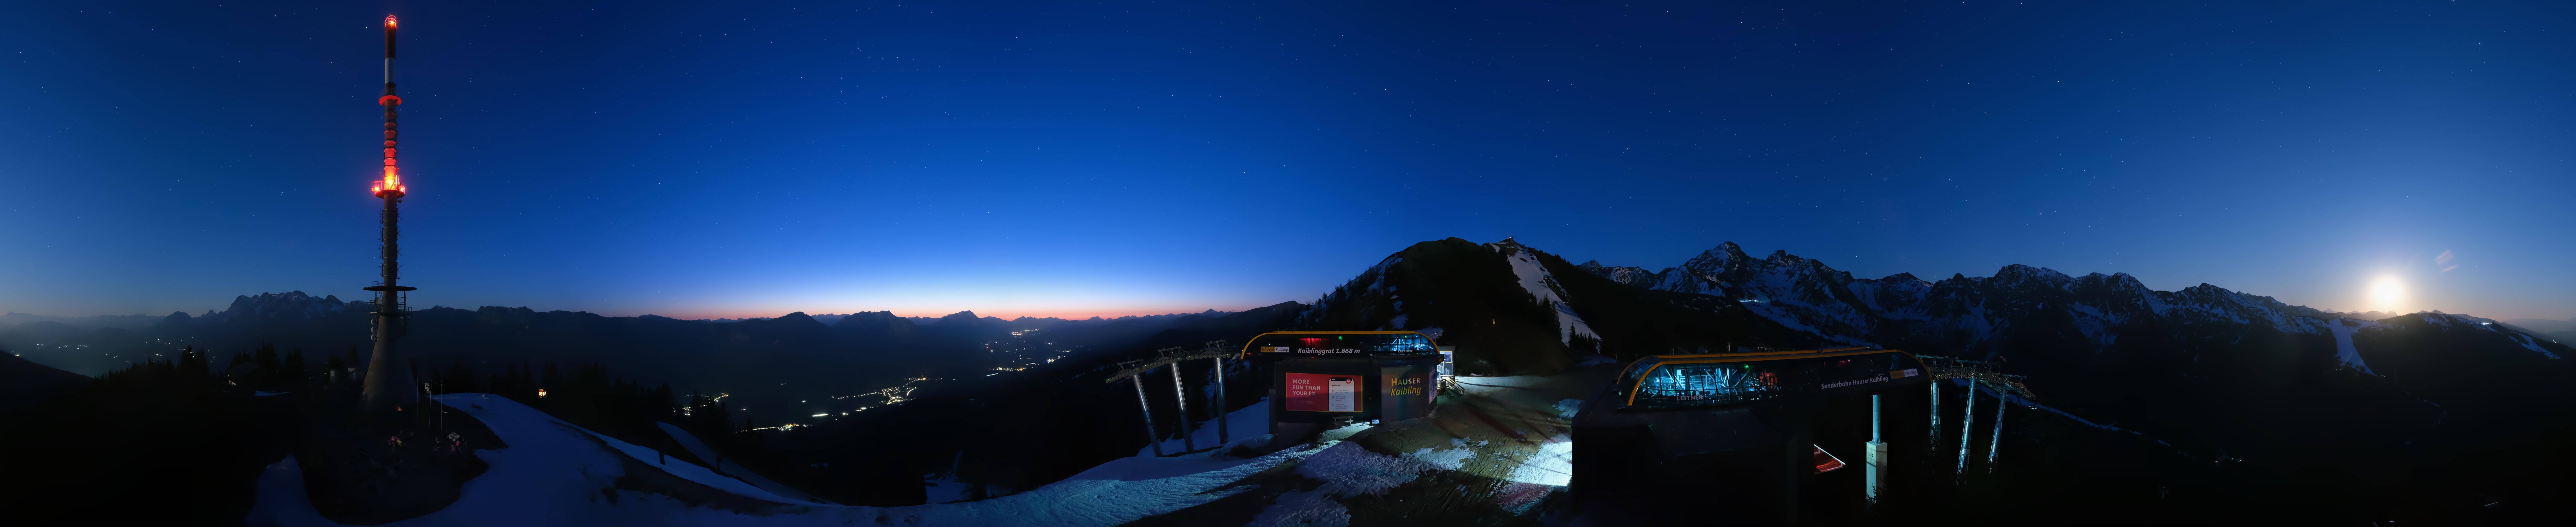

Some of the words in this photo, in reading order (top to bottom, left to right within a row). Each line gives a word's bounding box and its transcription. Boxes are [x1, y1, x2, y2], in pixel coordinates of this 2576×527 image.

[1391, 378, 1420, 386] HAUSER
[1821, 380, 1852, 389] Senderbahn
[1391, 386, 1421, 396] Kaibling
